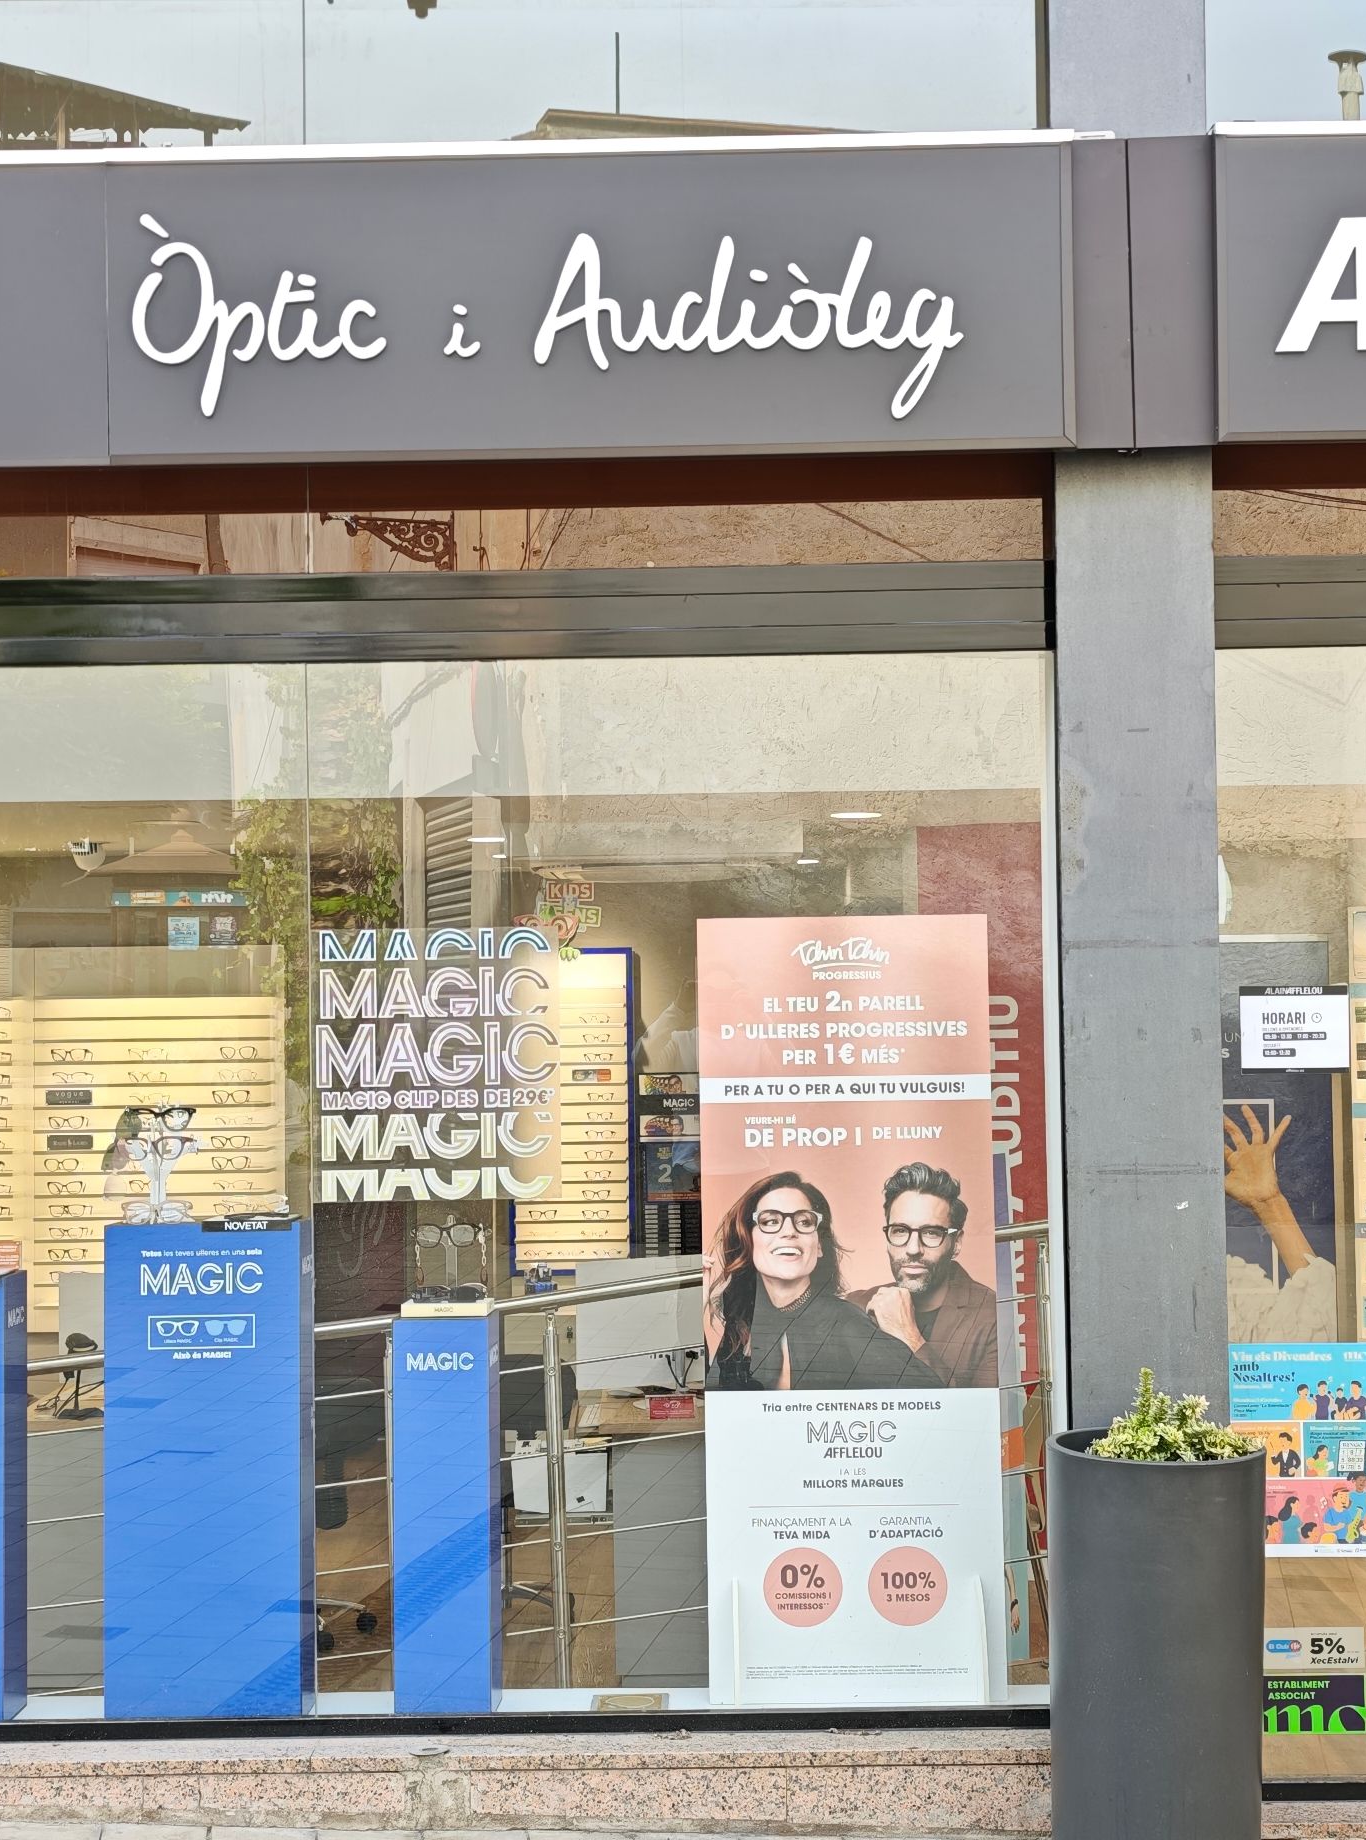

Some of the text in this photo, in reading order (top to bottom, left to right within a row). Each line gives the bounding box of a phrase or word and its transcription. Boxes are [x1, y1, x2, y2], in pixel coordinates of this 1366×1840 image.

[131, 213, 965, 420] Òptic i Audiòleg
[550, 883, 591, 898] KIDS
[790, 936, 890, 967] Tchin Tchin
[812, 970, 882, 981] PROGRESSIUS
[318, 966, 551, 1020] MAGIC
[763, 990, 925, 1013] EL TEU 2n PARELL
[1261, 1012, 1306, 1025] HORARI
[826, 1020, 968, 1038] PROGRESSIVES
[315, 1021, 559, 1089] MAGIC
[782, 1043, 855, 1065] PER 1€
[55, 1091, 84, 1099] vogue
[724, 1081, 966, 1097] PER A TU O PER A QUI TU VULGUIS!
[321, 1089, 510, 1110] MAGIC CLIP DES DE
[662, 1098, 695, 1108] MAGIC
[744, 1114, 796, 1125] VEURE-HI BÉ
[321, 1111, 554, 1162] MAGIC
[744, 1125, 943, 1148] DE PROP DE LLUNY
[224, 1220, 269, 1231] NOVETAT
[140, 1261, 264, 1296] MAGIC
[406, 1351, 475, 1372] MAGIC
[1273, 1351, 1332, 1362] Divendres
[1232, 1361, 1260, 1372] amb
[1233, 1371, 1296, 1383] Nosaltres!
[762, 1400, 941, 1412] Tria entre CENTENARS DE MODELS
[806, 1420, 897, 1444] MAGIC
[823, 1446, 883, 1459] AFFLELOU
[853, 1468, 867, 1476] LES
[803, 1478, 904, 1489] MILLORS MARQUES
[752, 1517, 852, 1529] FINANÇAMENT LA
[879, 1516, 932, 1526] GARANTIA
[773, 1530, 831, 1540] TEVA MIDA
[869, 1525, 944, 1539] D'ADAPTACIÓ
[780, 1564, 825, 1589] 0%
[880, 1571, 936, 1590] 100%
[775, 1592, 826, 1600] COMISSIONS
[895, 1593, 931, 1602] MESOS
[1310, 1637, 1346, 1655] 5%
[1310, 1656, 1359, 1665] XecEstalvi
[1267, 1681, 1330, 1689] ESTABLIMENT
[1268, 1691, 1316, 1700] ASSOCIAT
